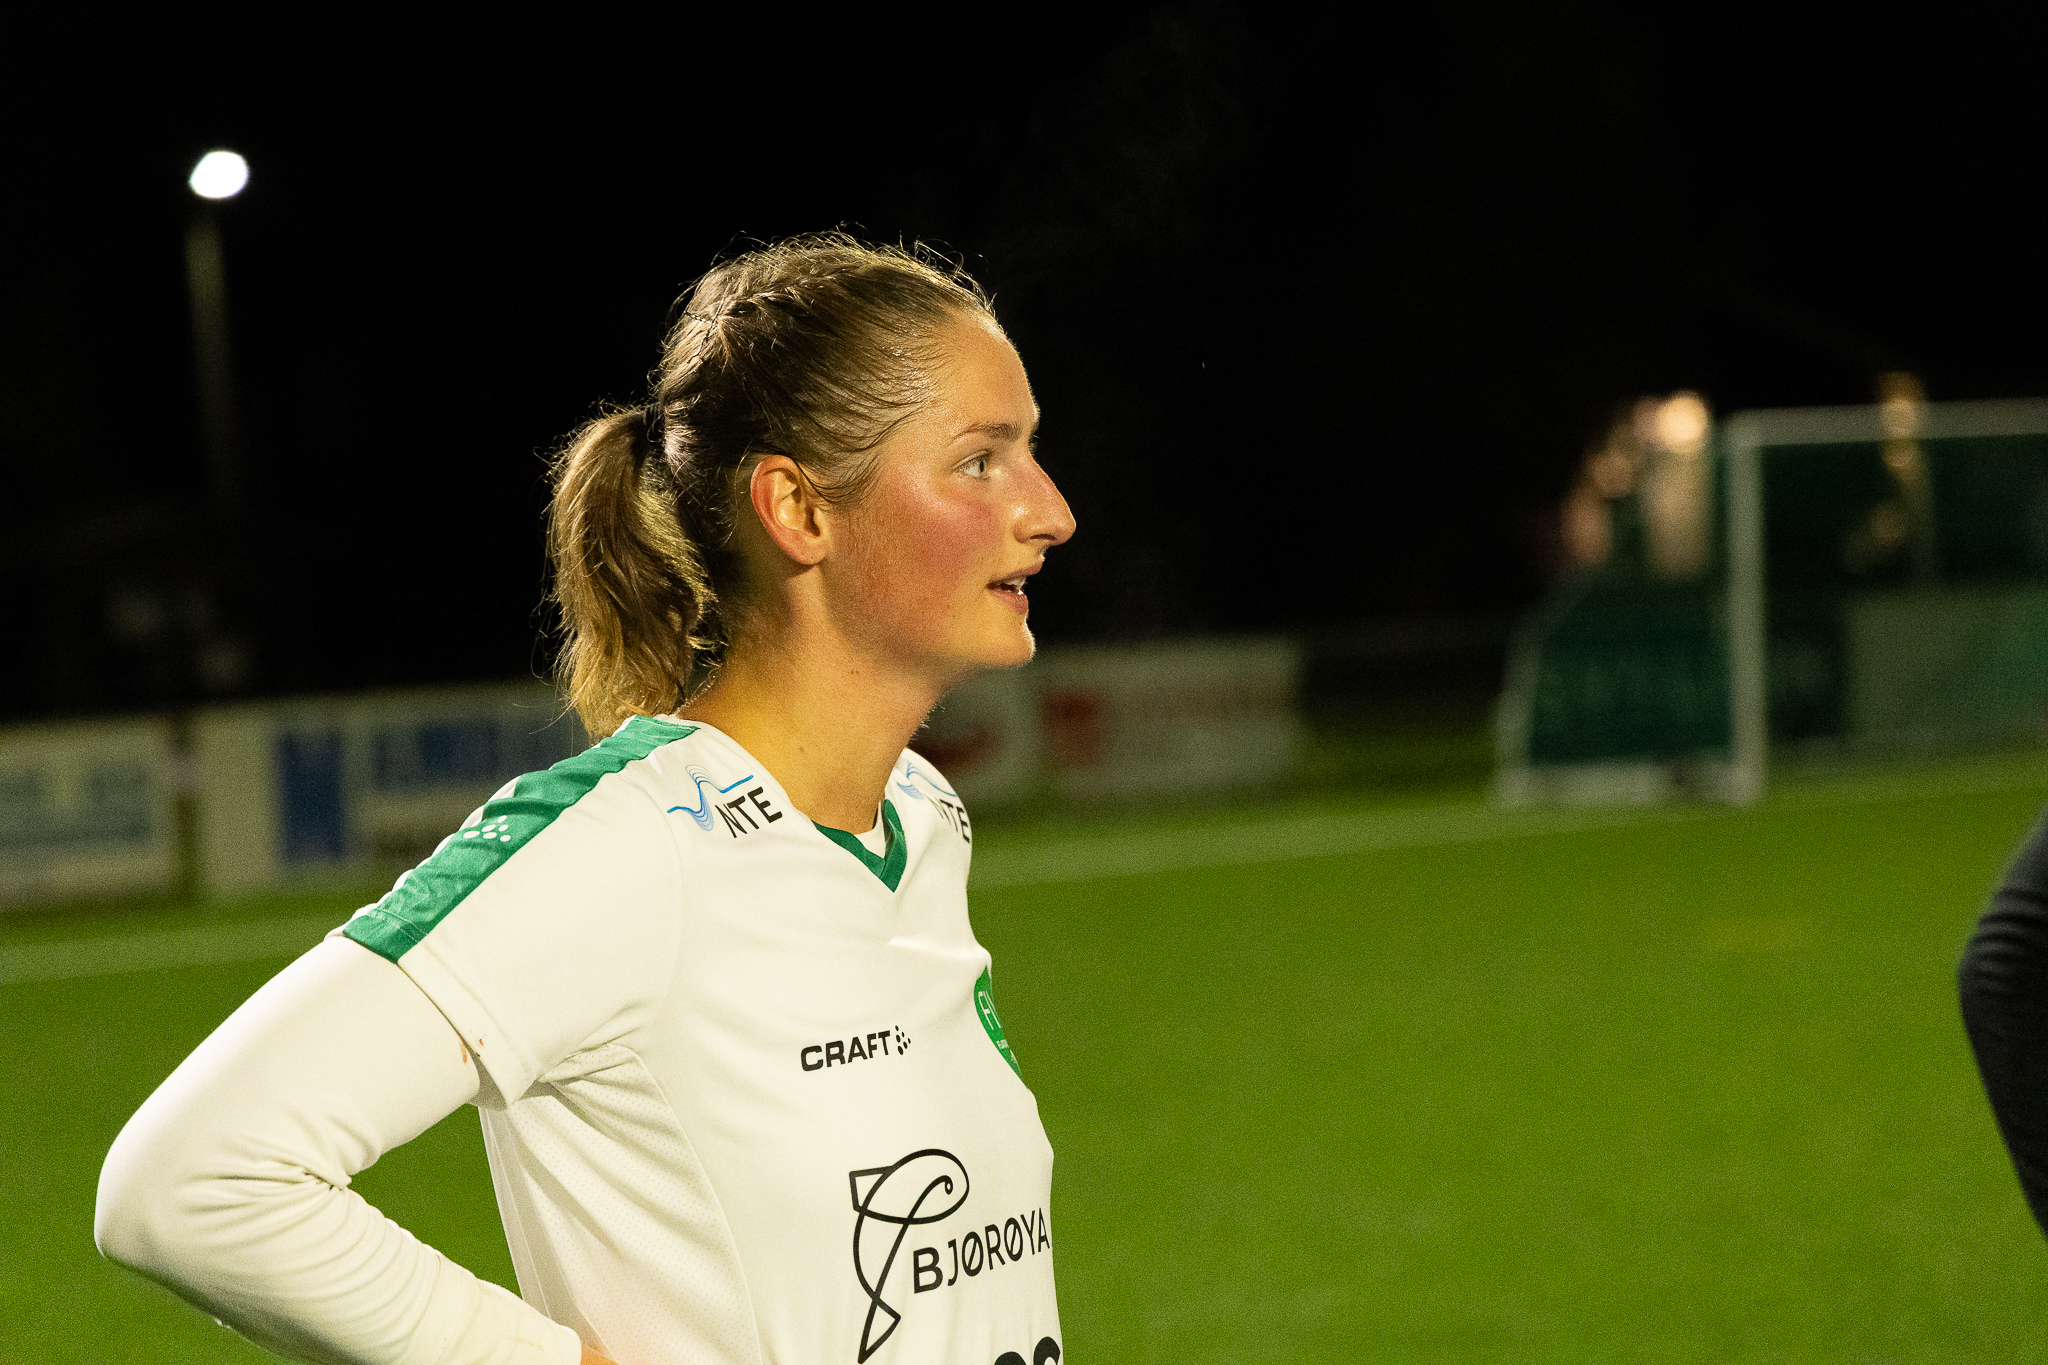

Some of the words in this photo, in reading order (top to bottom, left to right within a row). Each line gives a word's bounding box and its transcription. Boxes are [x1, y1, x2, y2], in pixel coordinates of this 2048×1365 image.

[714, 786, 783, 839] NTE
[800, 1030, 891, 1072] CRAFT
[912, 1206, 1051, 1294] BJØRØYA
